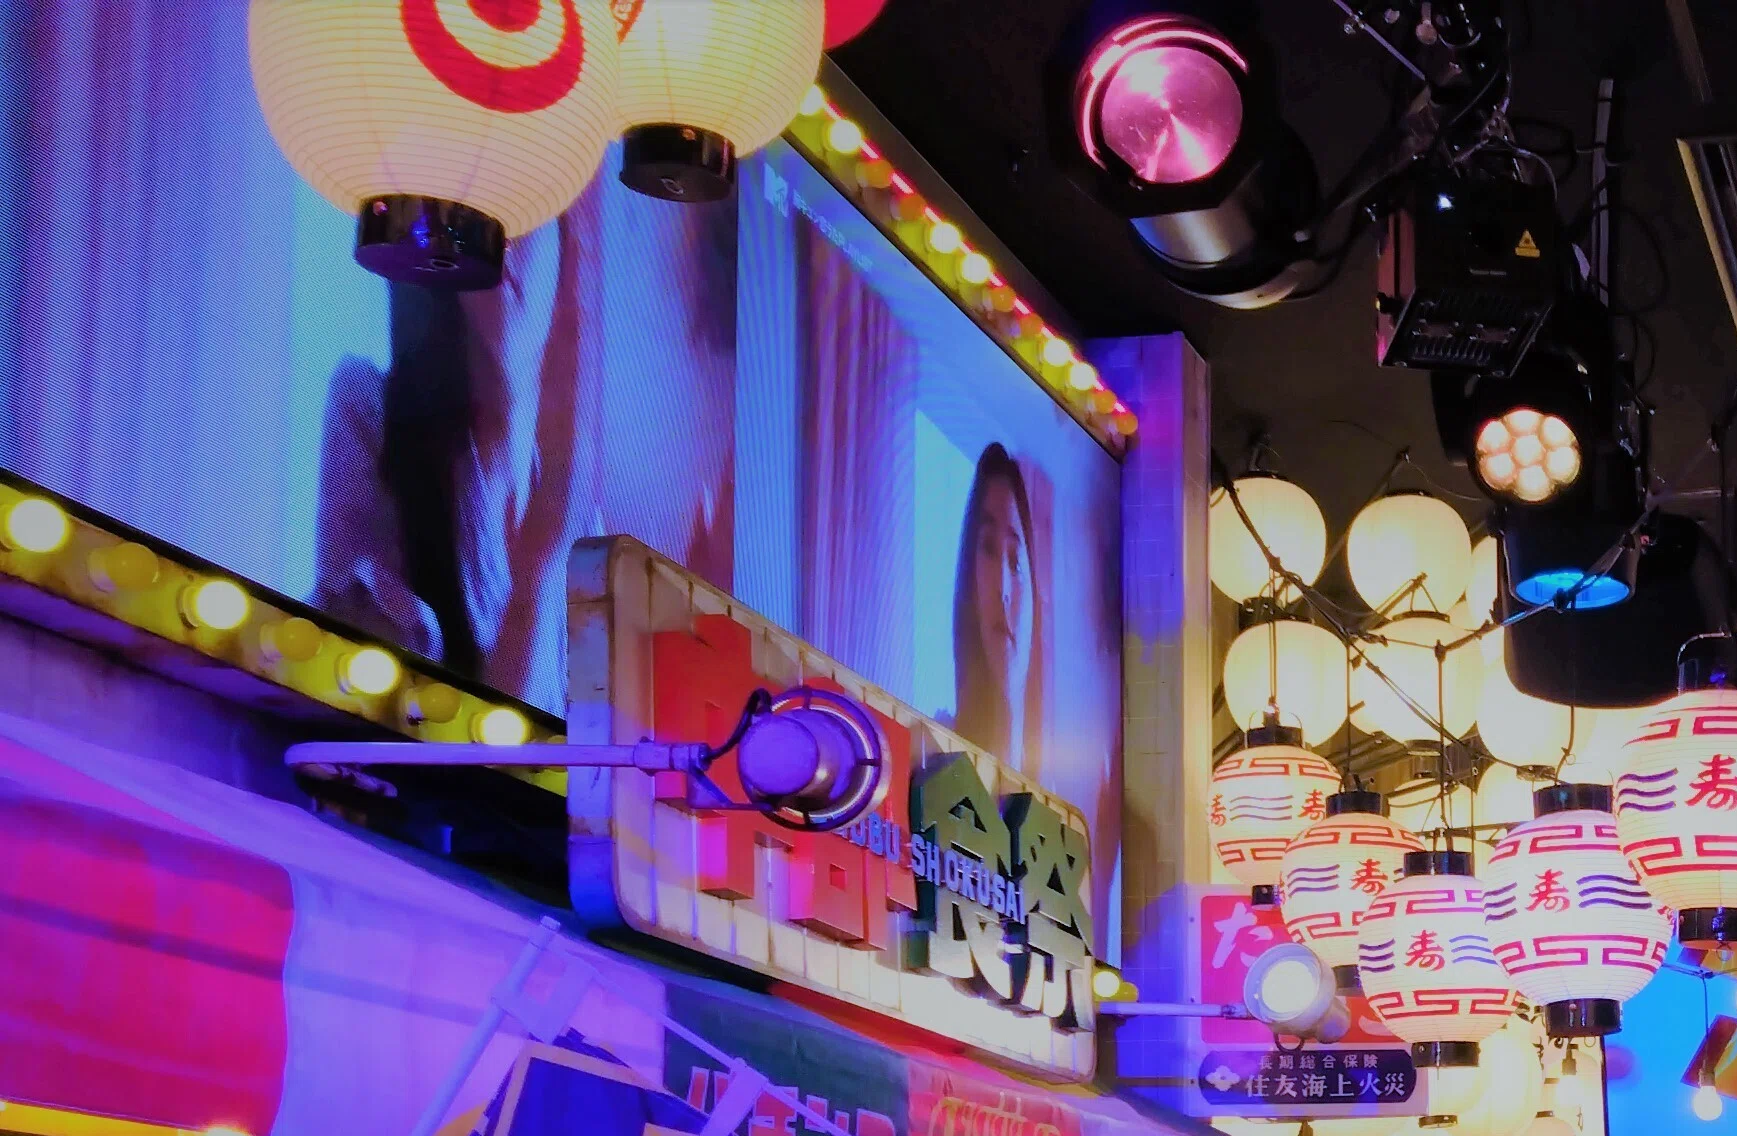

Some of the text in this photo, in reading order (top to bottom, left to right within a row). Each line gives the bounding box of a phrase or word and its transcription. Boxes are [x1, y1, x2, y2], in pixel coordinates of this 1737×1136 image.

[910, 833, 1026, 925] SHOKUSAI
[1526, 868, 1570, 913] 寿
[1404, 930, 1446, 972] 寿
[1258, 1054, 1379, 1071] 長期総合保険
[1245, 1072, 1406, 1098] 住友海上火災
